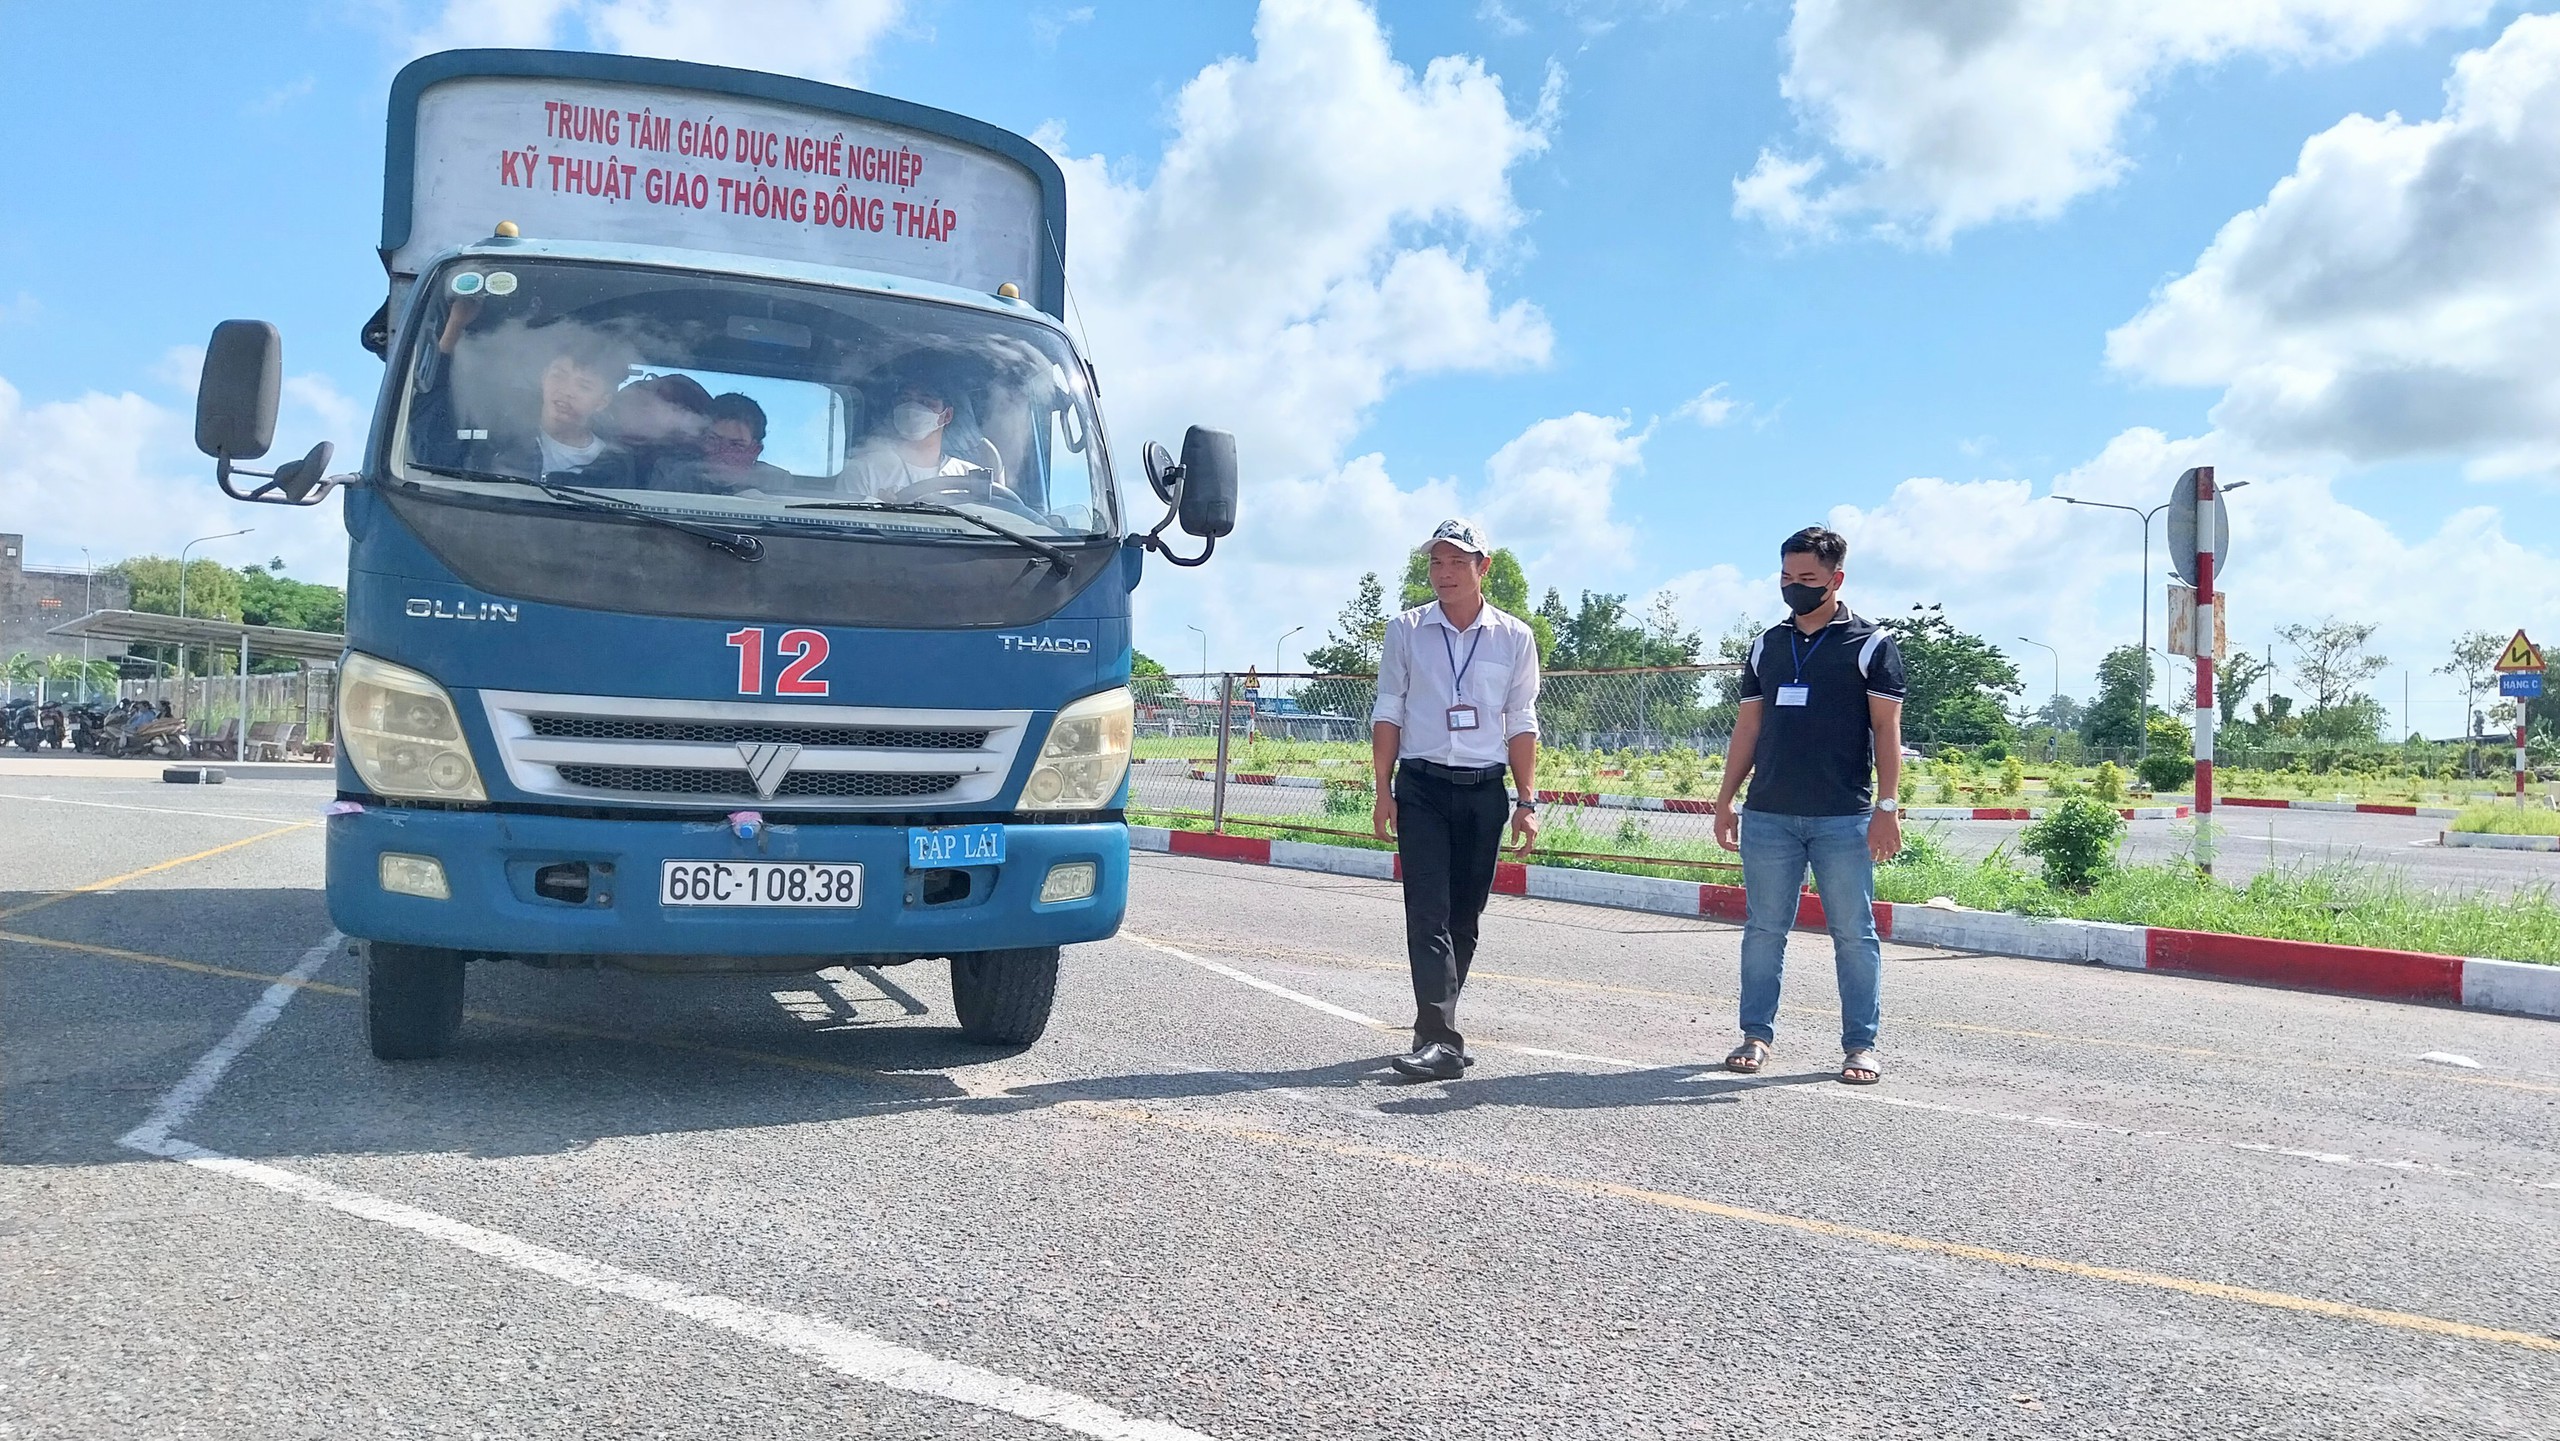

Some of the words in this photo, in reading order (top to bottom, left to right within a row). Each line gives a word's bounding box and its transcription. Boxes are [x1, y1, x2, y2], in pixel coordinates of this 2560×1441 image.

[545, 101, 620, 146] TRUNG
[627, 107, 671, 153] TÂM
[677, 115, 729, 161] GIÁO
[736, 128, 778, 173] DỤC
[784, 132, 844, 178] NGHỀ
[848, 145, 923, 193] NGHIỆP
[501, 144, 540, 189] KỸ
[547, 155, 637, 204] THUẬT
[645, 168, 709, 210] GIAO
[717, 175, 807, 223] THÔNG
[813, 183, 884, 233] ĐỒNG
[892, 199, 957, 243] THÁP
[405, 598, 519, 622] OLLIN
[725, 627, 830, 697] 12
[997, 634, 1091, 654] THACO
[2531, 680, 2538, 689] C
[914, 830, 957, 865] TẬP
[963, 826, 998, 858] LÁI
[669, 866, 855, 903] 66C-108.38
